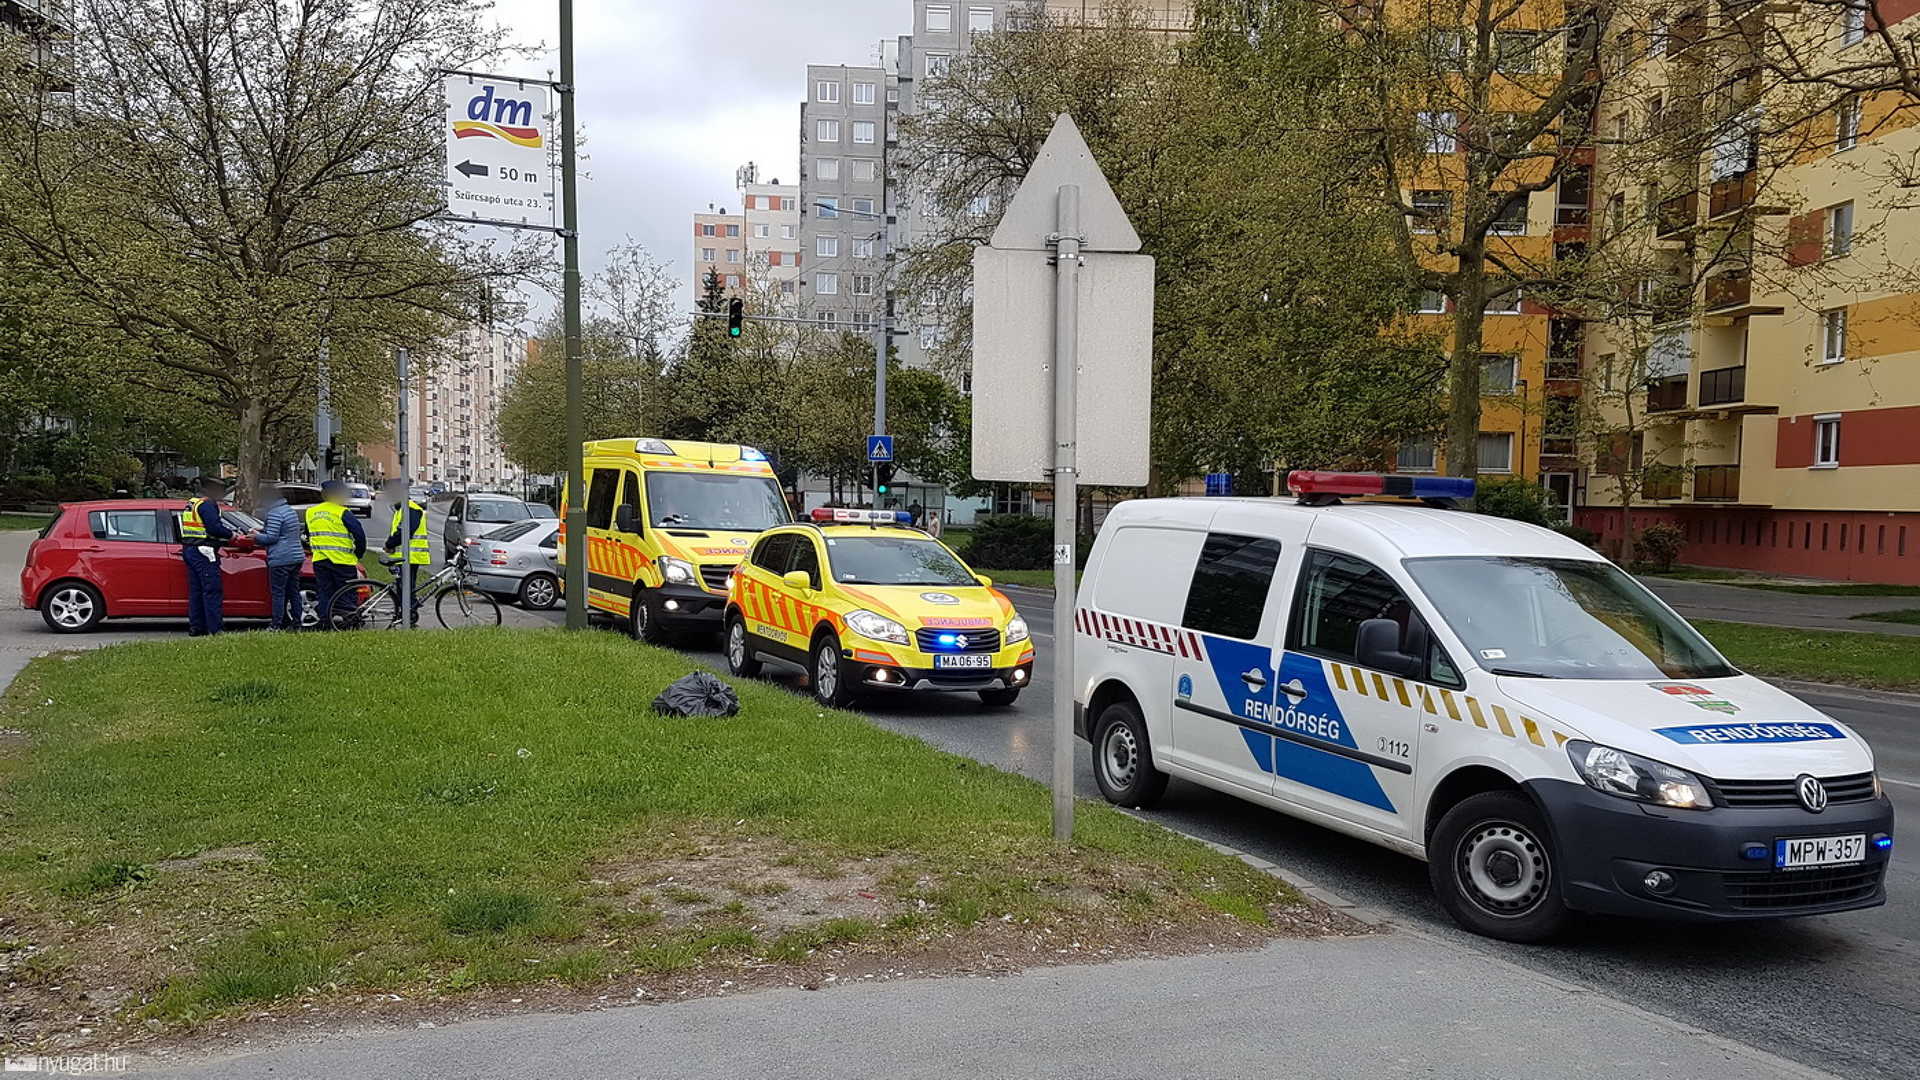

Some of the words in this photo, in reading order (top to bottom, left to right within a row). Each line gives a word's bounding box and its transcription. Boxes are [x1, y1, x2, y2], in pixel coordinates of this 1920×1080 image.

[467, 85, 532, 126] dm
[499, 167, 519, 181] 50
[524, 172, 537, 183] m
[503, 197, 524, 207] utca
[527, 198, 542, 209] 23.
[1244, 698, 1340, 741] RENDŐRSÉG
[1688, 722, 1832, 743] RENDŐRSÉG
[1388, 738, 1409, 759] 112
[1789, 838, 1863, 864] MPW-357
